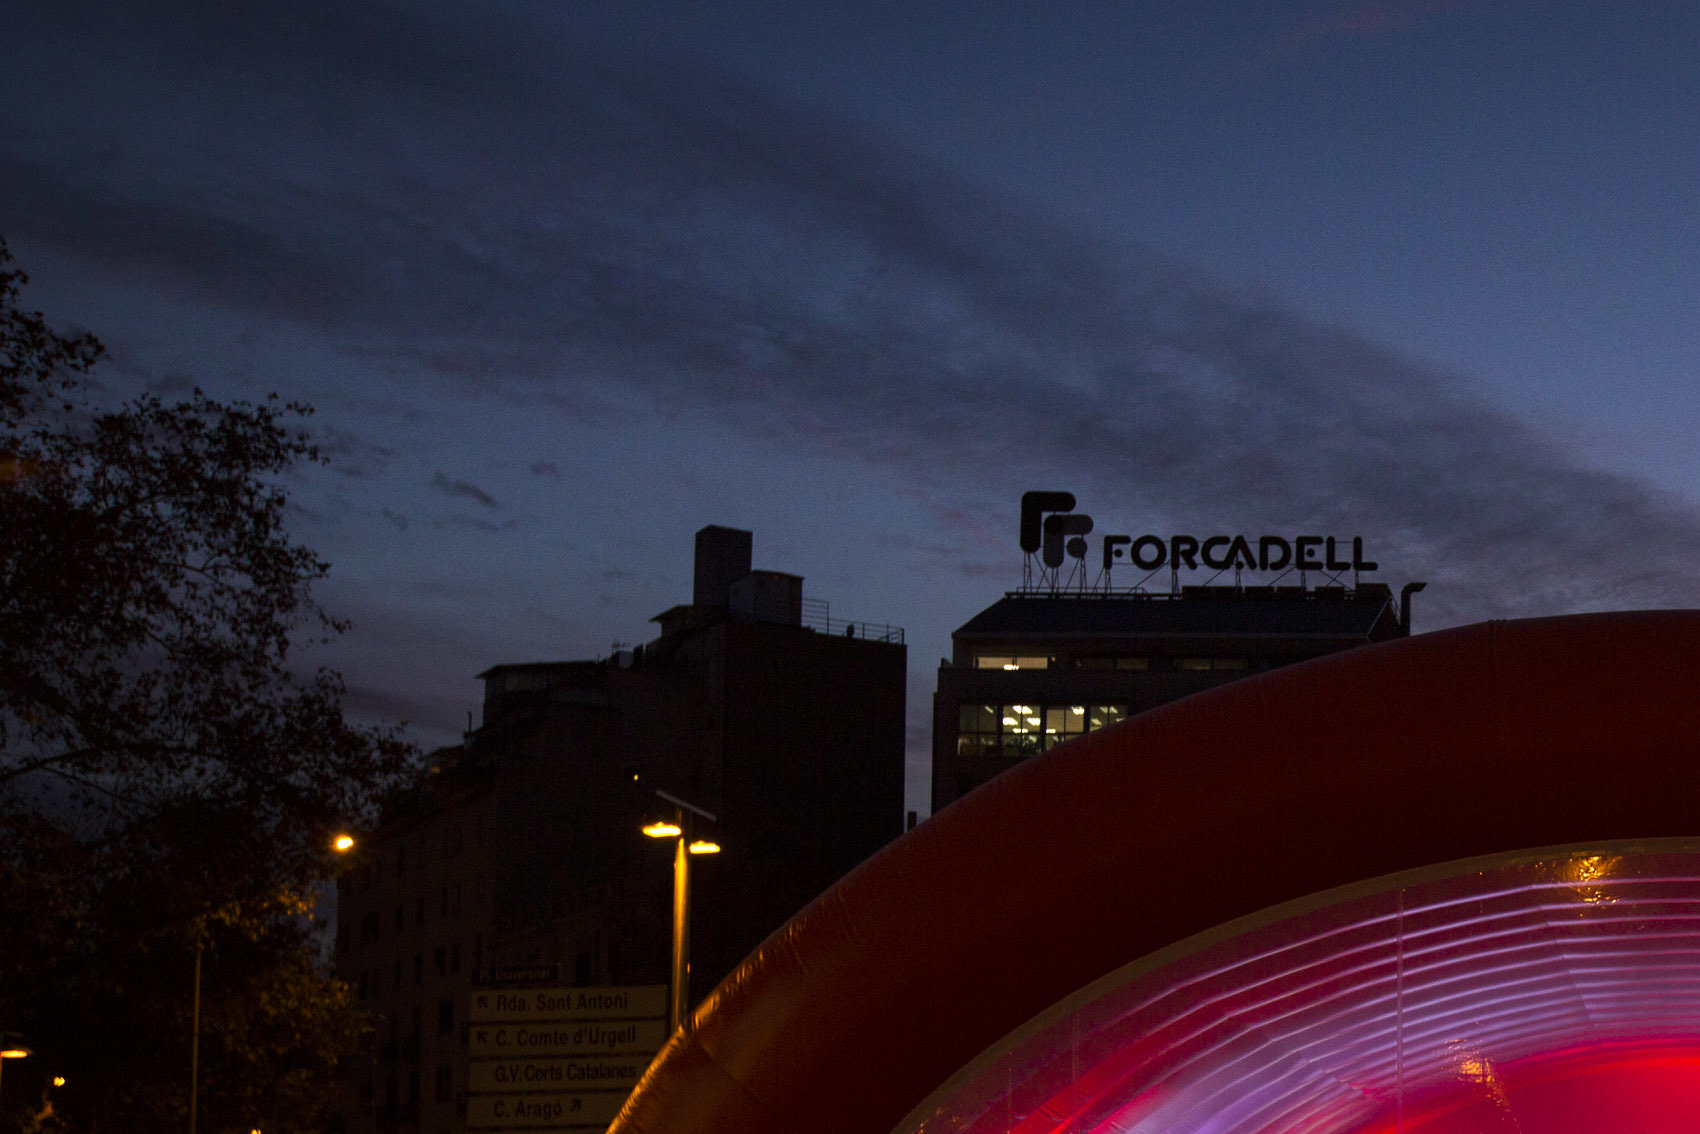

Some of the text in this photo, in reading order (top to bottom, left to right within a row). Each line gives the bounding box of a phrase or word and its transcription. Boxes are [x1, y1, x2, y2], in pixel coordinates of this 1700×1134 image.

[1103, 534, 1378, 571] FORCADELL
[497, 992, 628, 1011] Rda. Sant Antoni
[495, 1025, 636, 1048] C. Comte d'Urgell
[566, 1063, 637, 1081] Catalanes
[493, 1098, 562, 1120] C. Aragó
